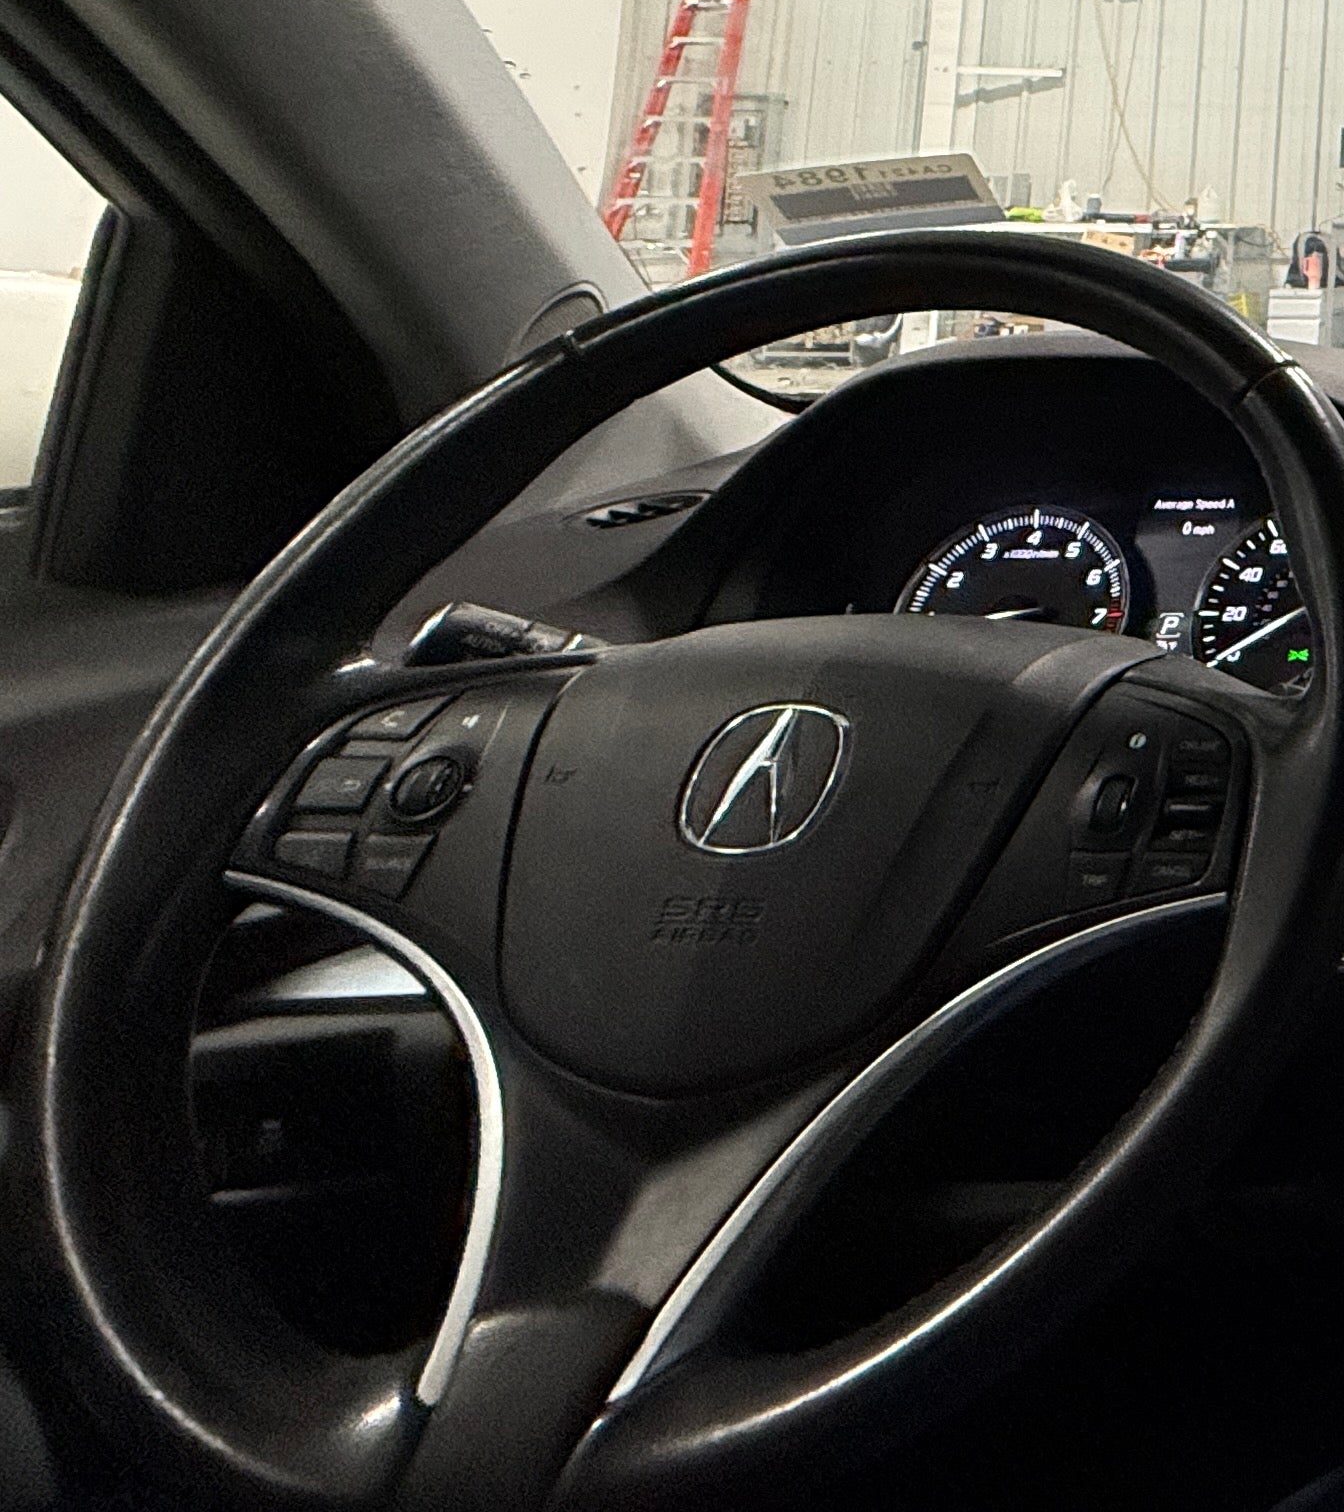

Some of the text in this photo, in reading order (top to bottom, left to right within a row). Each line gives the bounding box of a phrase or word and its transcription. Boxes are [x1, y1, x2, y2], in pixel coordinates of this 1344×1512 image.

[1154, 498, 1235, 511] Average Speed A
[1182, 520, 1193, 535] 0
[1026, 529, 1043, 545] 4
[980, 542, 999, 560] 3
[1063, 541, 1082, 559] 5
[946, 571, 965, 589] 2
[1085, 569, 1103, 586] 6
[1239, 566, 1264, 583] 40
[1090, 607, 1108, 625] 7
[1222, 606, 1248, 622] 20
[1160, 615, 1180, 635] P
[660, 895, 768, 923] SRS
